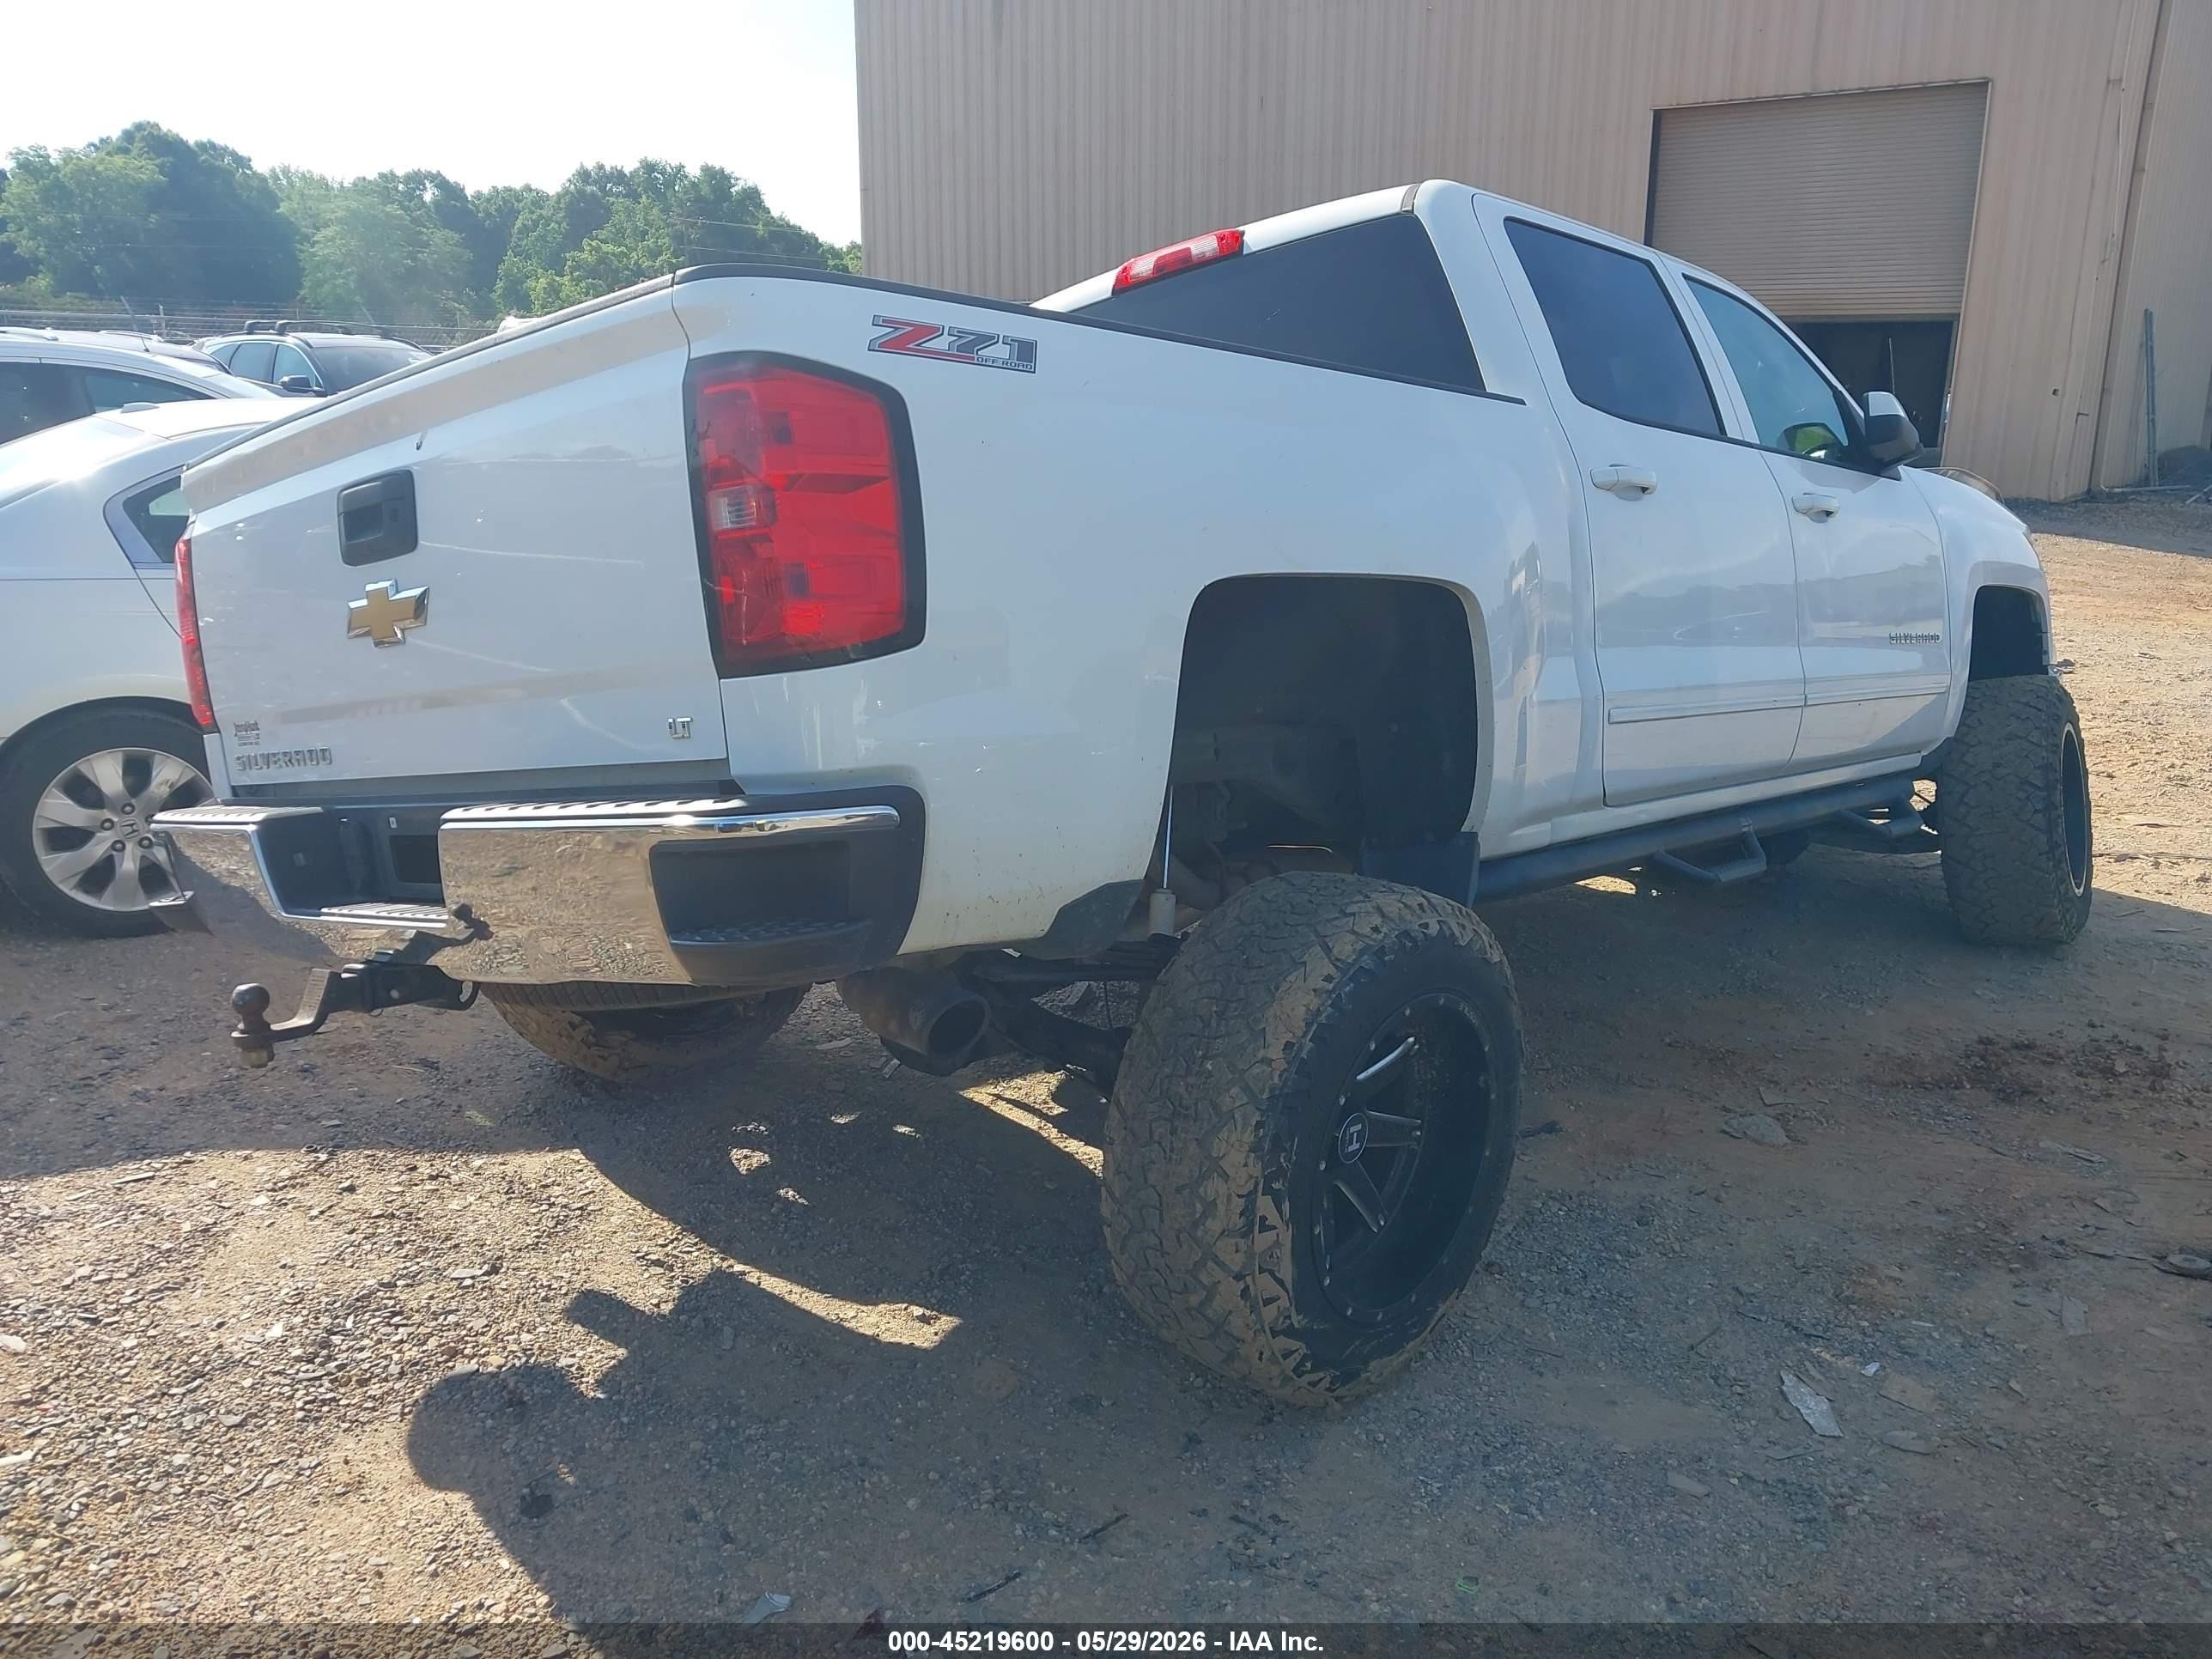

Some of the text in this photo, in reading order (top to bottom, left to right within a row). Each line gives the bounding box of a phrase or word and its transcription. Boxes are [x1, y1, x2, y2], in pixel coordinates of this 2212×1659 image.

[867, 314, 1037, 369] Z71
[1002, 360, 1033, 370] ROAD
[667, 717, 692, 738] LT
[234, 746, 333, 771] SILVERADO
